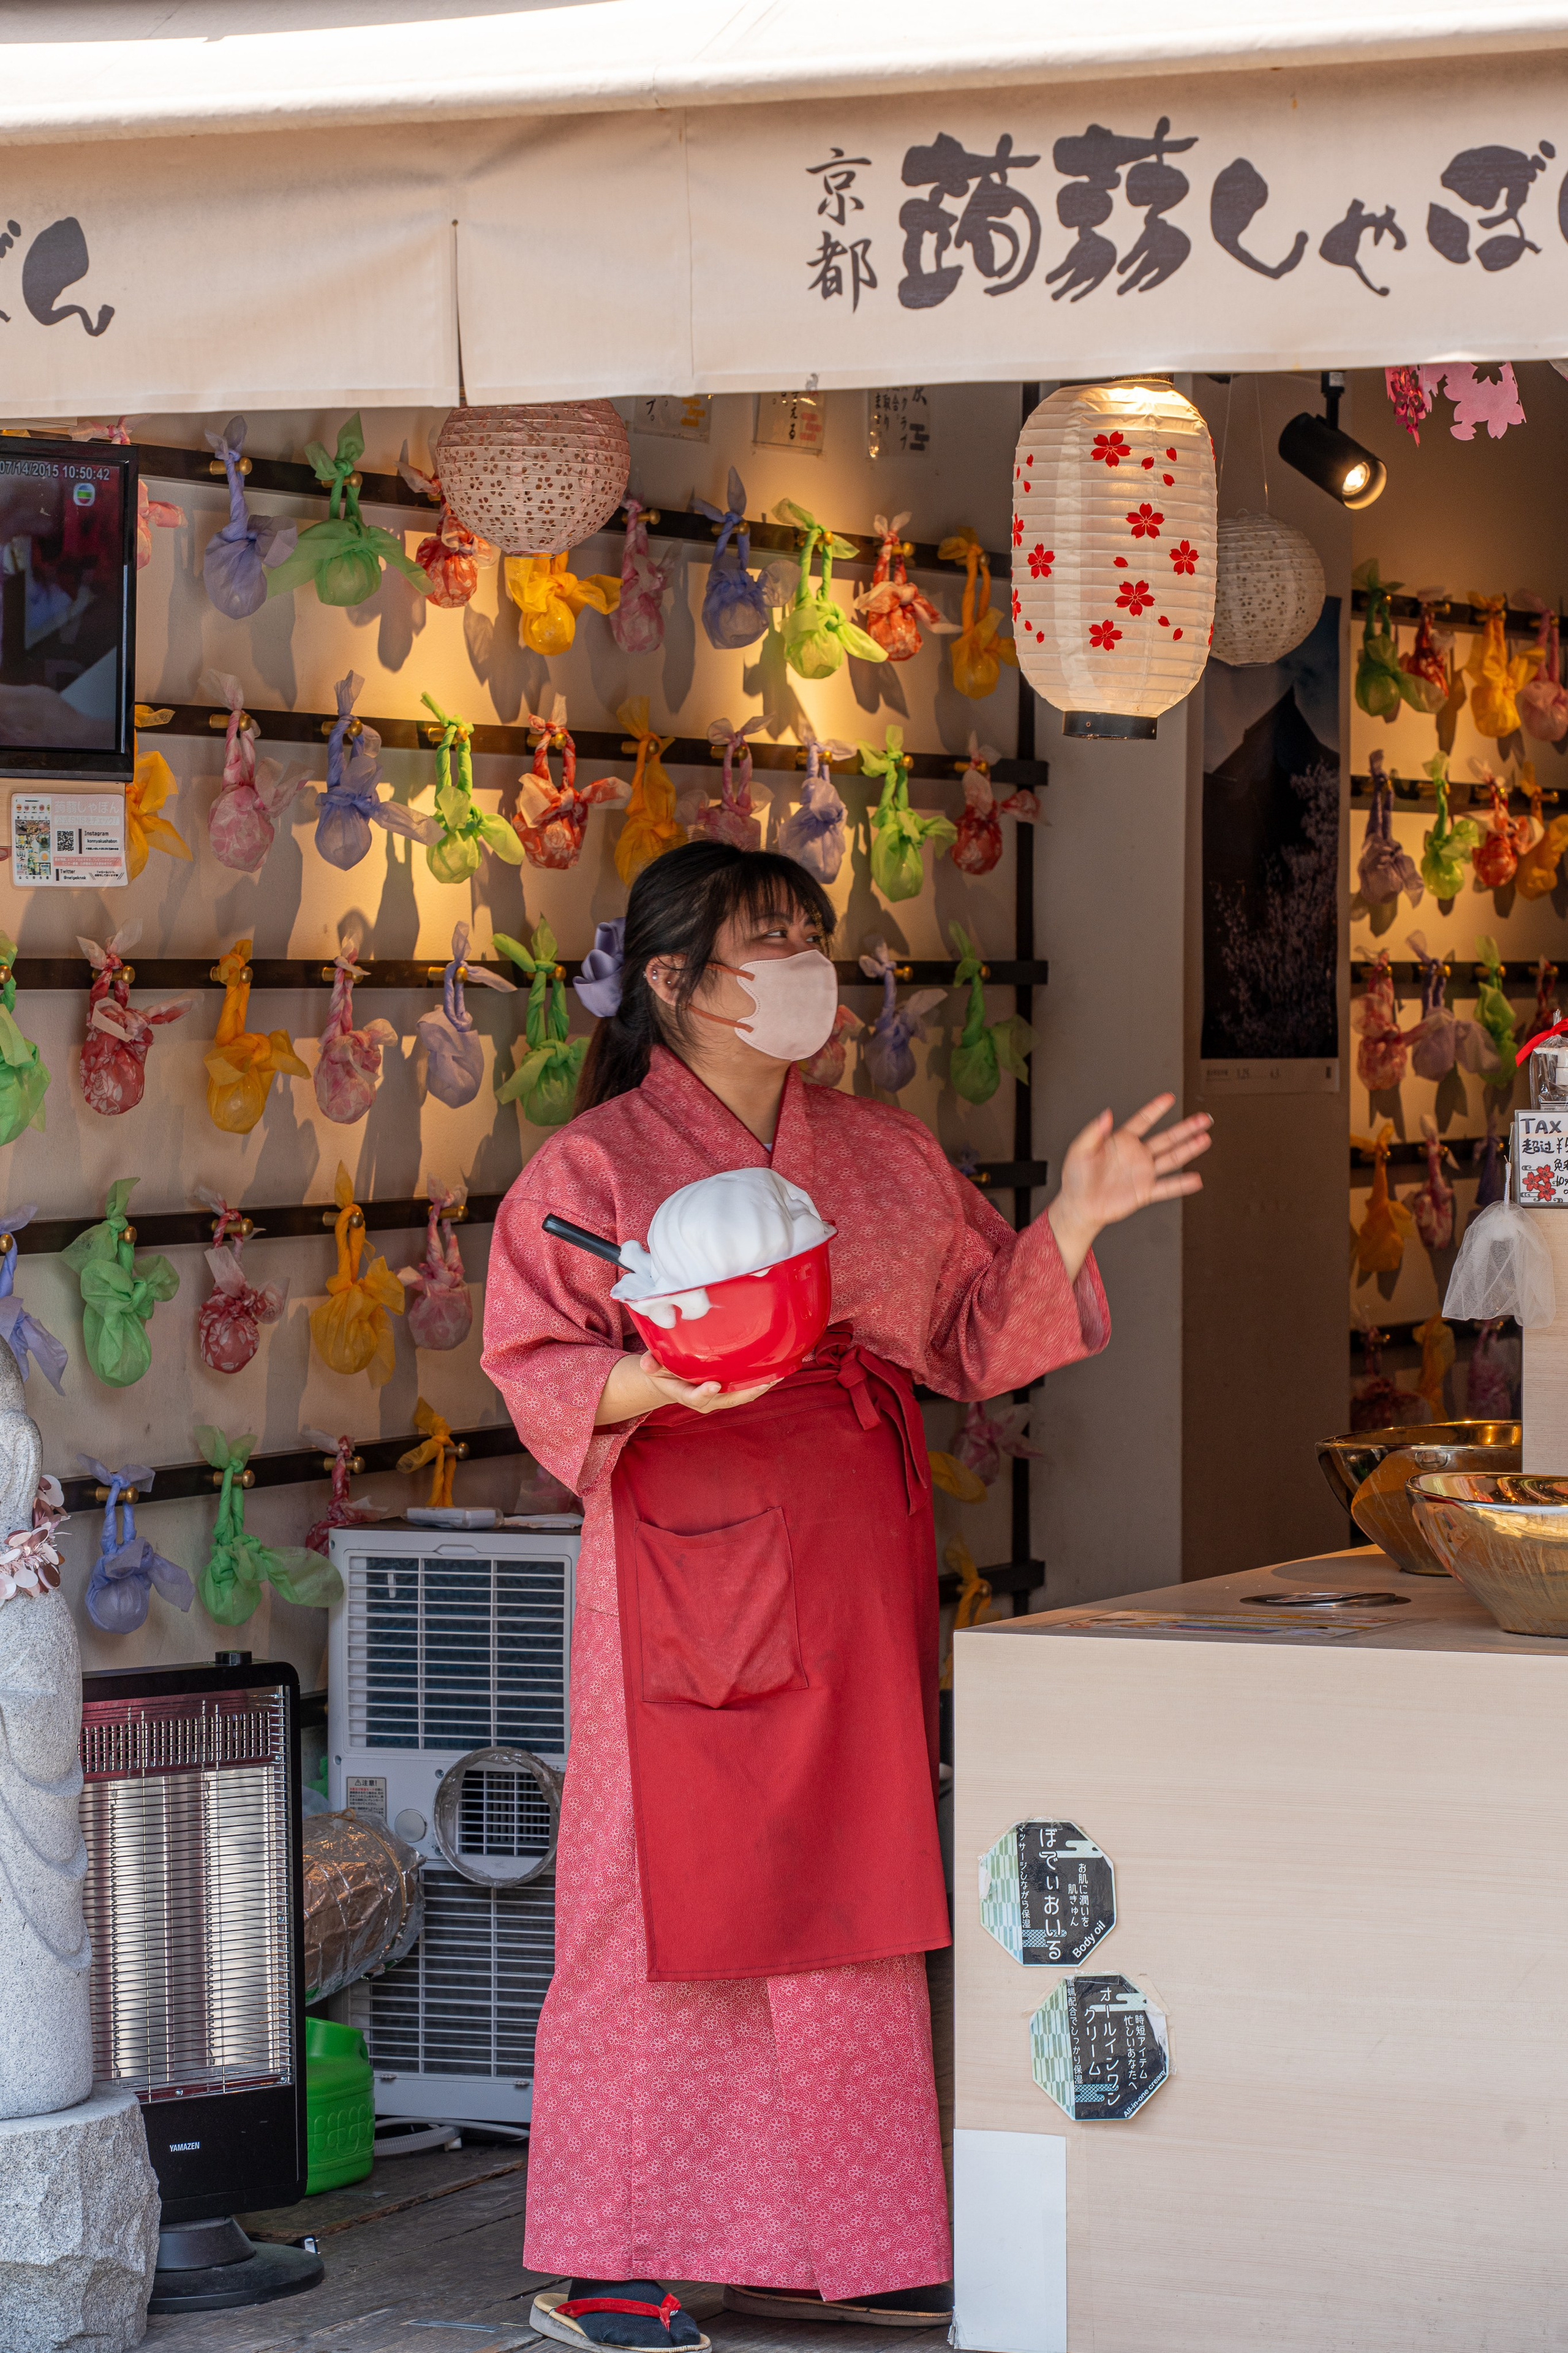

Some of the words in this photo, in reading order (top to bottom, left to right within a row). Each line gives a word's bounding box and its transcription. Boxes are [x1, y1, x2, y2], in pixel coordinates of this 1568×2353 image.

[806, 147, 877, 314] 京都
[898, 116, 1568, 309] 蒟蒻しゃぼ
[0, 461, 59, 478] 07/14/2015
[62, 465, 110, 481] 10:50:42
[1520, 1118, 1562, 1134] TAX
[1018, 1825, 1031, 1928] マッサージしながら保湿
[1068, 1884, 1079, 1927] 肌きゅん
[1078, 1863, 1089, 1927] お肌に潤いを
[1072, 1934, 1096, 1958] Body
[1094, 1920, 1106, 1936] oil
[1084, 2008, 1101, 2075] クリーム
[1100, 1987, 1120, 2106] オールインワン
[1123, 2015, 1137, 2090] 忙しいあなたへ
[1134, 2014, 1148, 2079] 時短アイテム
[1123, 2089, 1150, 2118] All-in-one
[1148, 2071, 1166, 2090] cream
[169, 2142, 200, 2152] YAMAZEN
